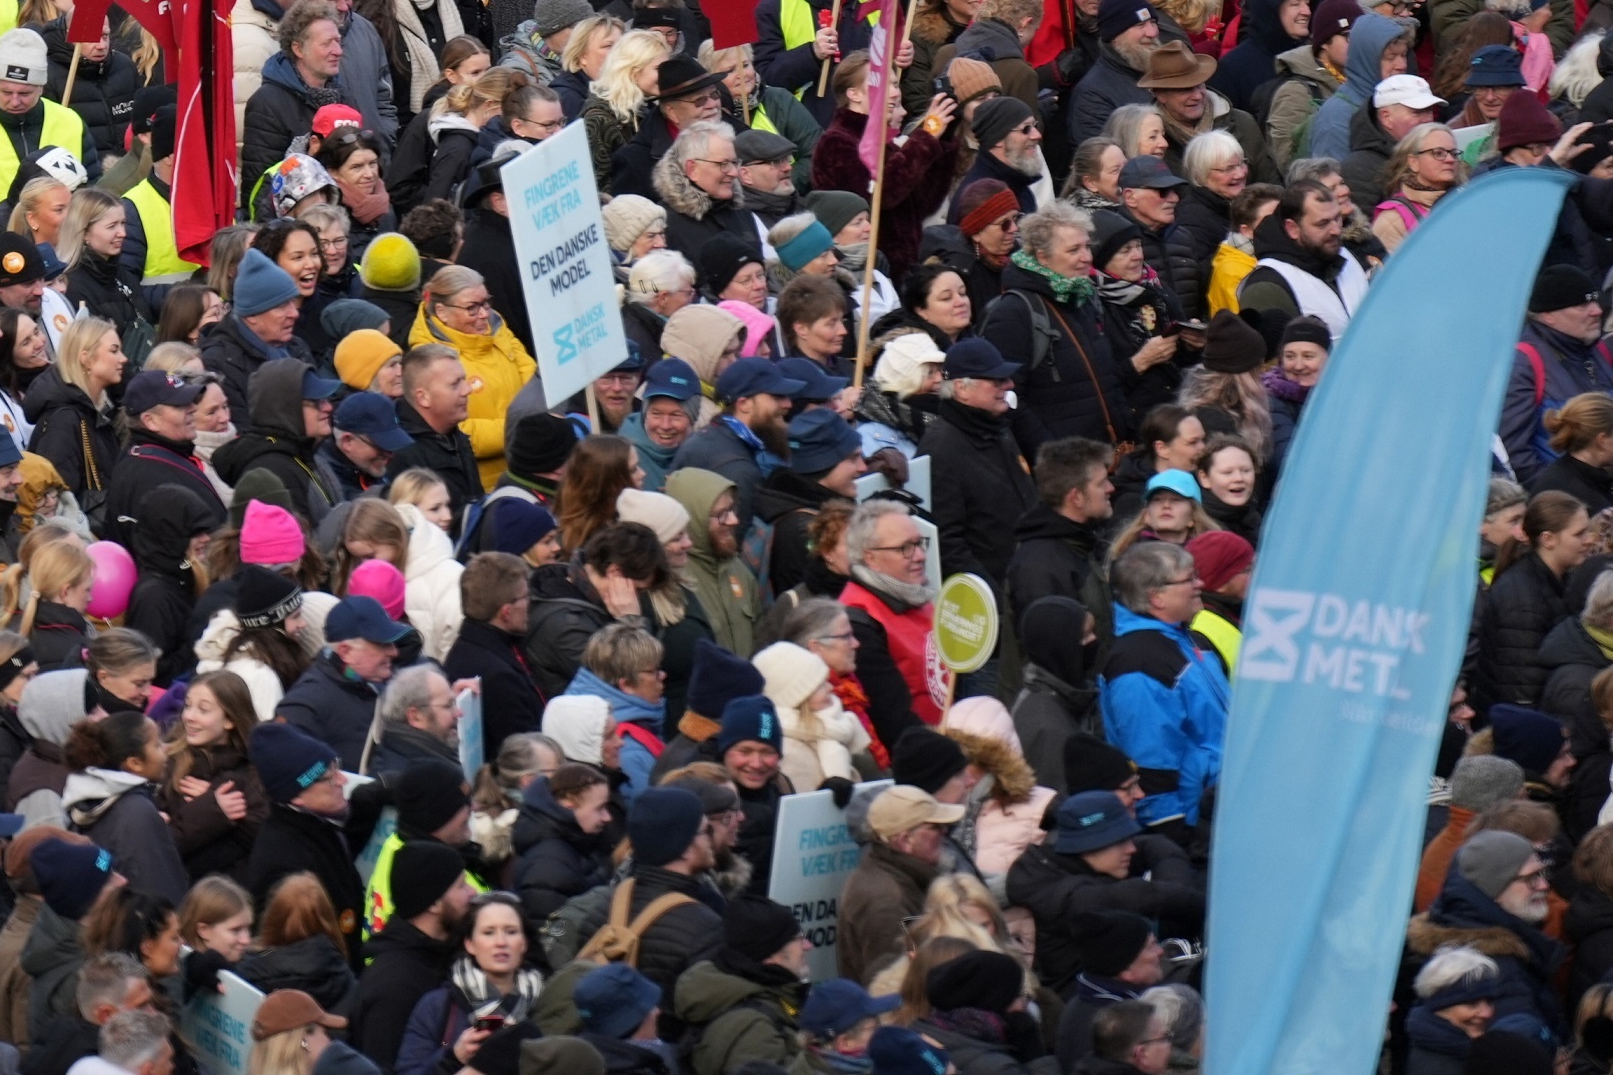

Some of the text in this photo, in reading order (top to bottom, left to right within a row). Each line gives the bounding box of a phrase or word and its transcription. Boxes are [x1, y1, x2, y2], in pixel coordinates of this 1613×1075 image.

[525, 161, 579, 209] FINGRENE
[532, 225, 599, 280] DEN DANSKE
[551, 259, 591, 297] MODEL
